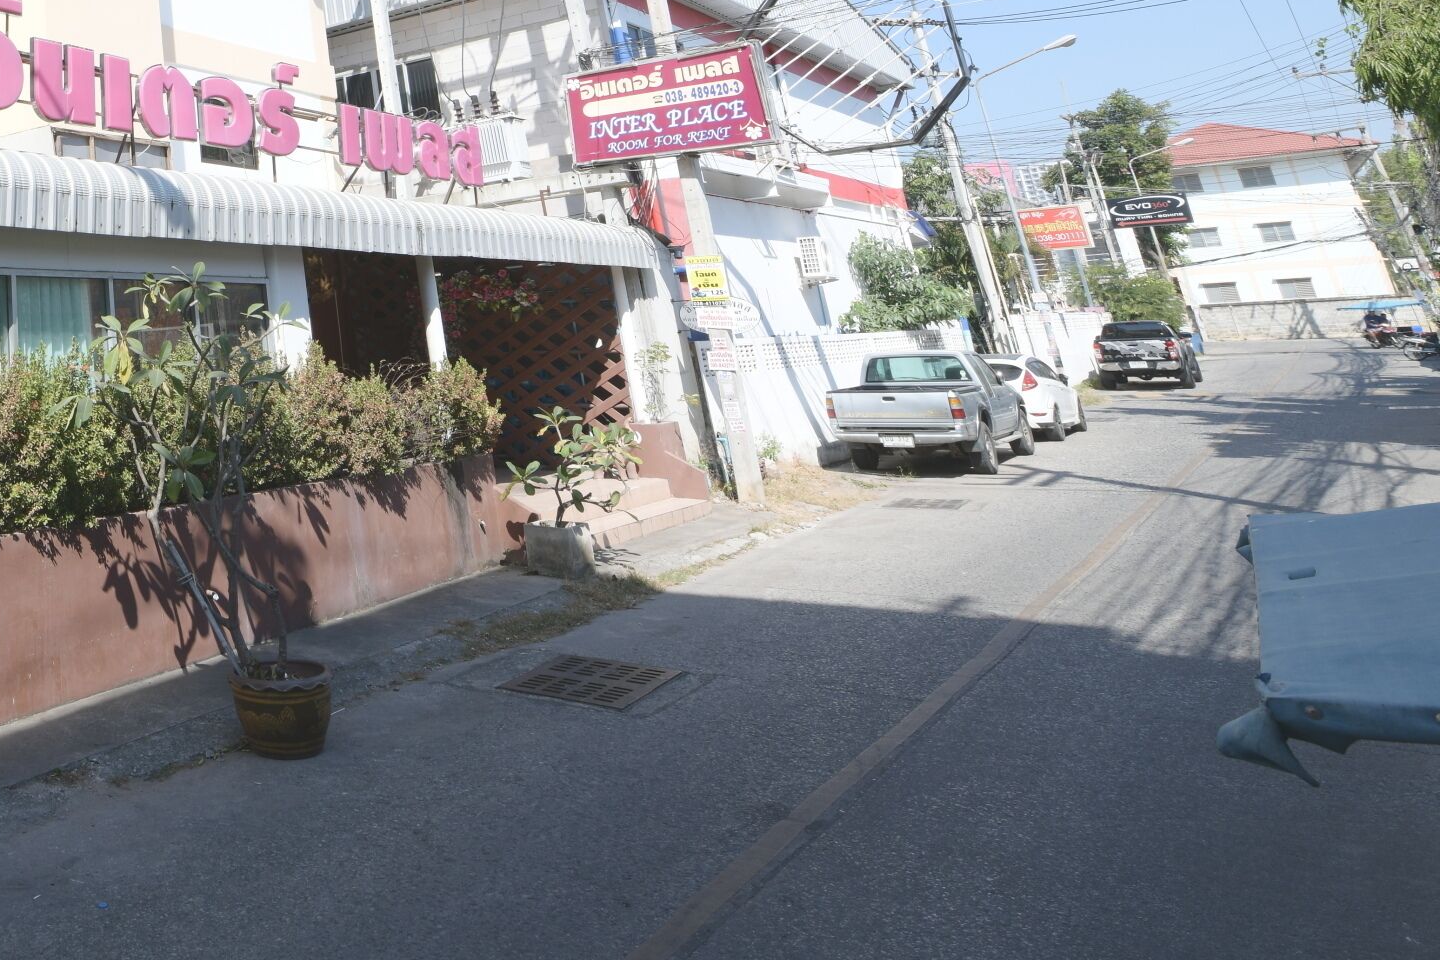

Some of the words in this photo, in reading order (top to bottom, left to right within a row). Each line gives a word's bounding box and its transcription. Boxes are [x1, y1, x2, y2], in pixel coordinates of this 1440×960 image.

[580, 64, 663, 100] อินเตอร์
[674, 55, 740, 84] เพลส
[589, 114, 662, 139] INTER
[667, 100, 747, 128] PLACE
[608, 139, 648, 152] ROOM
[654, 134, 687, 147] FOR
[687, 126, 731, 142] RENT
[337, 102, 484, 188] เพลส
